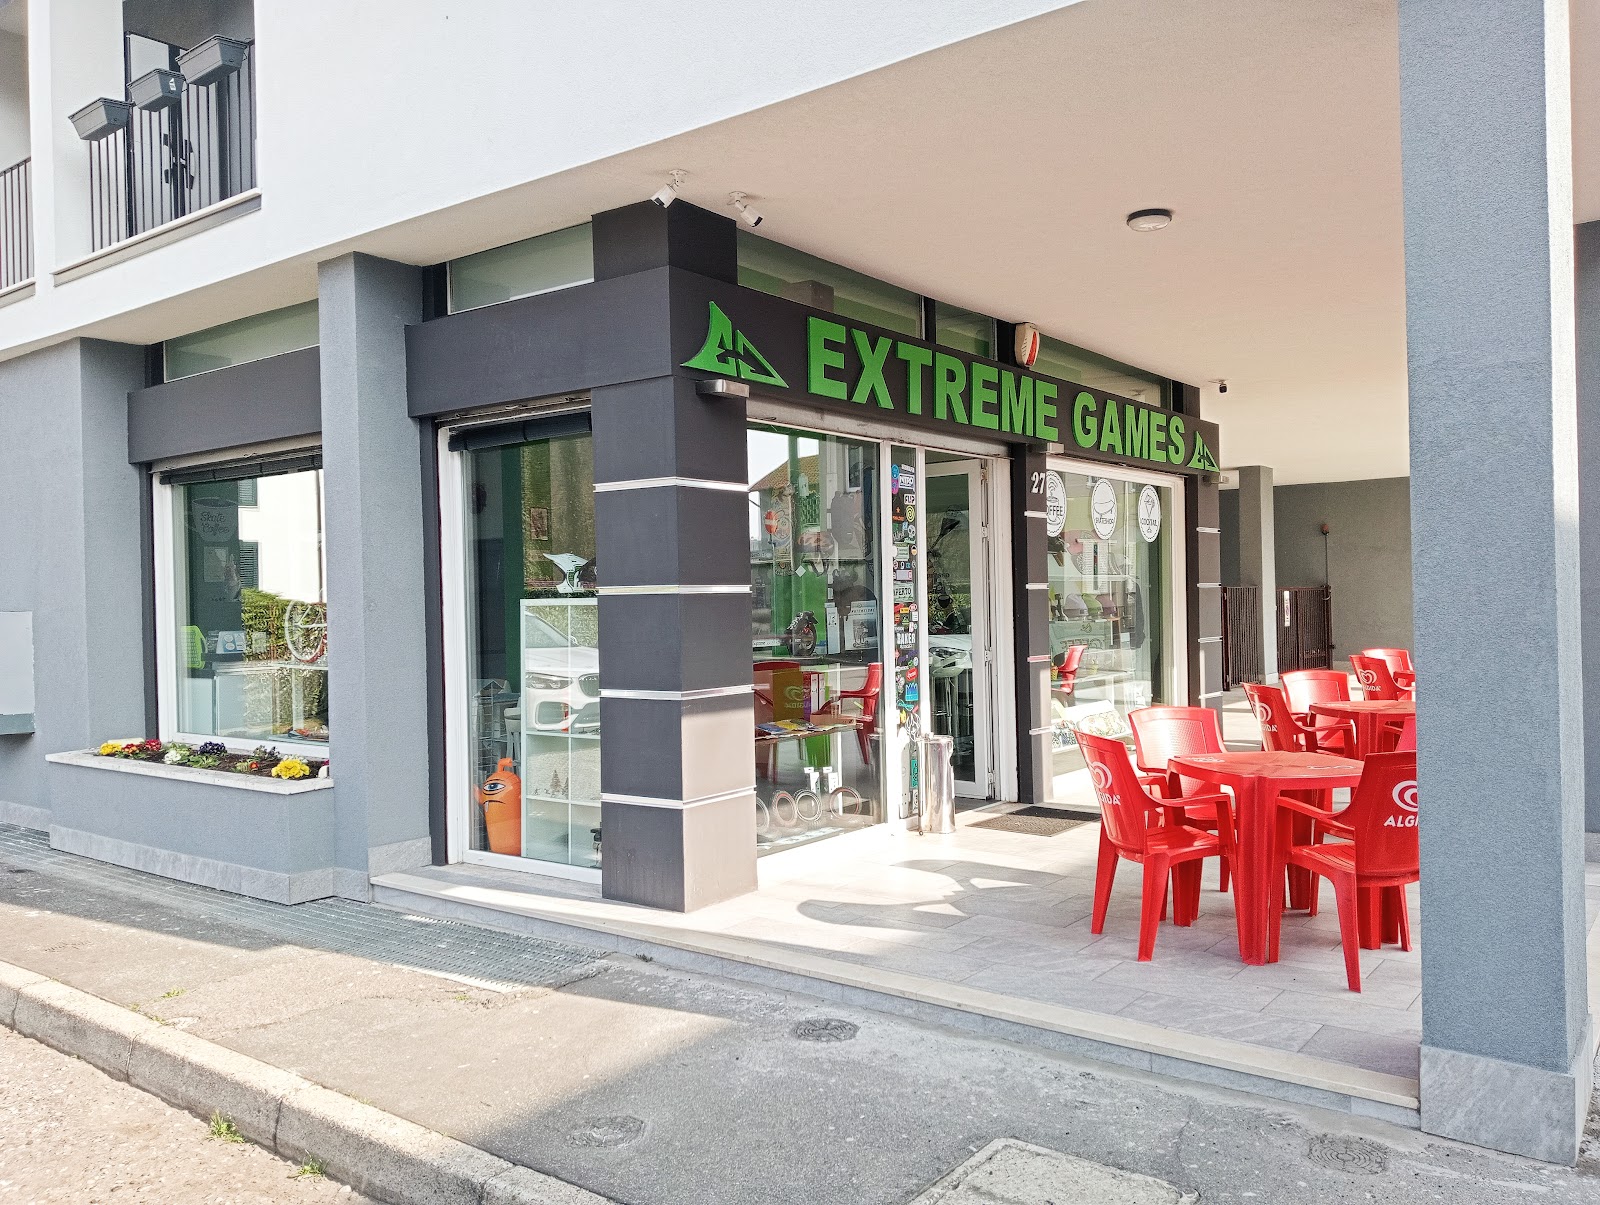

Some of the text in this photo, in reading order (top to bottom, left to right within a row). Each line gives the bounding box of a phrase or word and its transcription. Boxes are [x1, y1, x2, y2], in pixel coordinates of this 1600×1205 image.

[807, 316, 1186, 465] EXTREME GAMES
[1031, 471, 1045, 494] 27
[1046, 504, 1063, 517] OFFEE
[1383, 815, 1418, 828] ALGI
